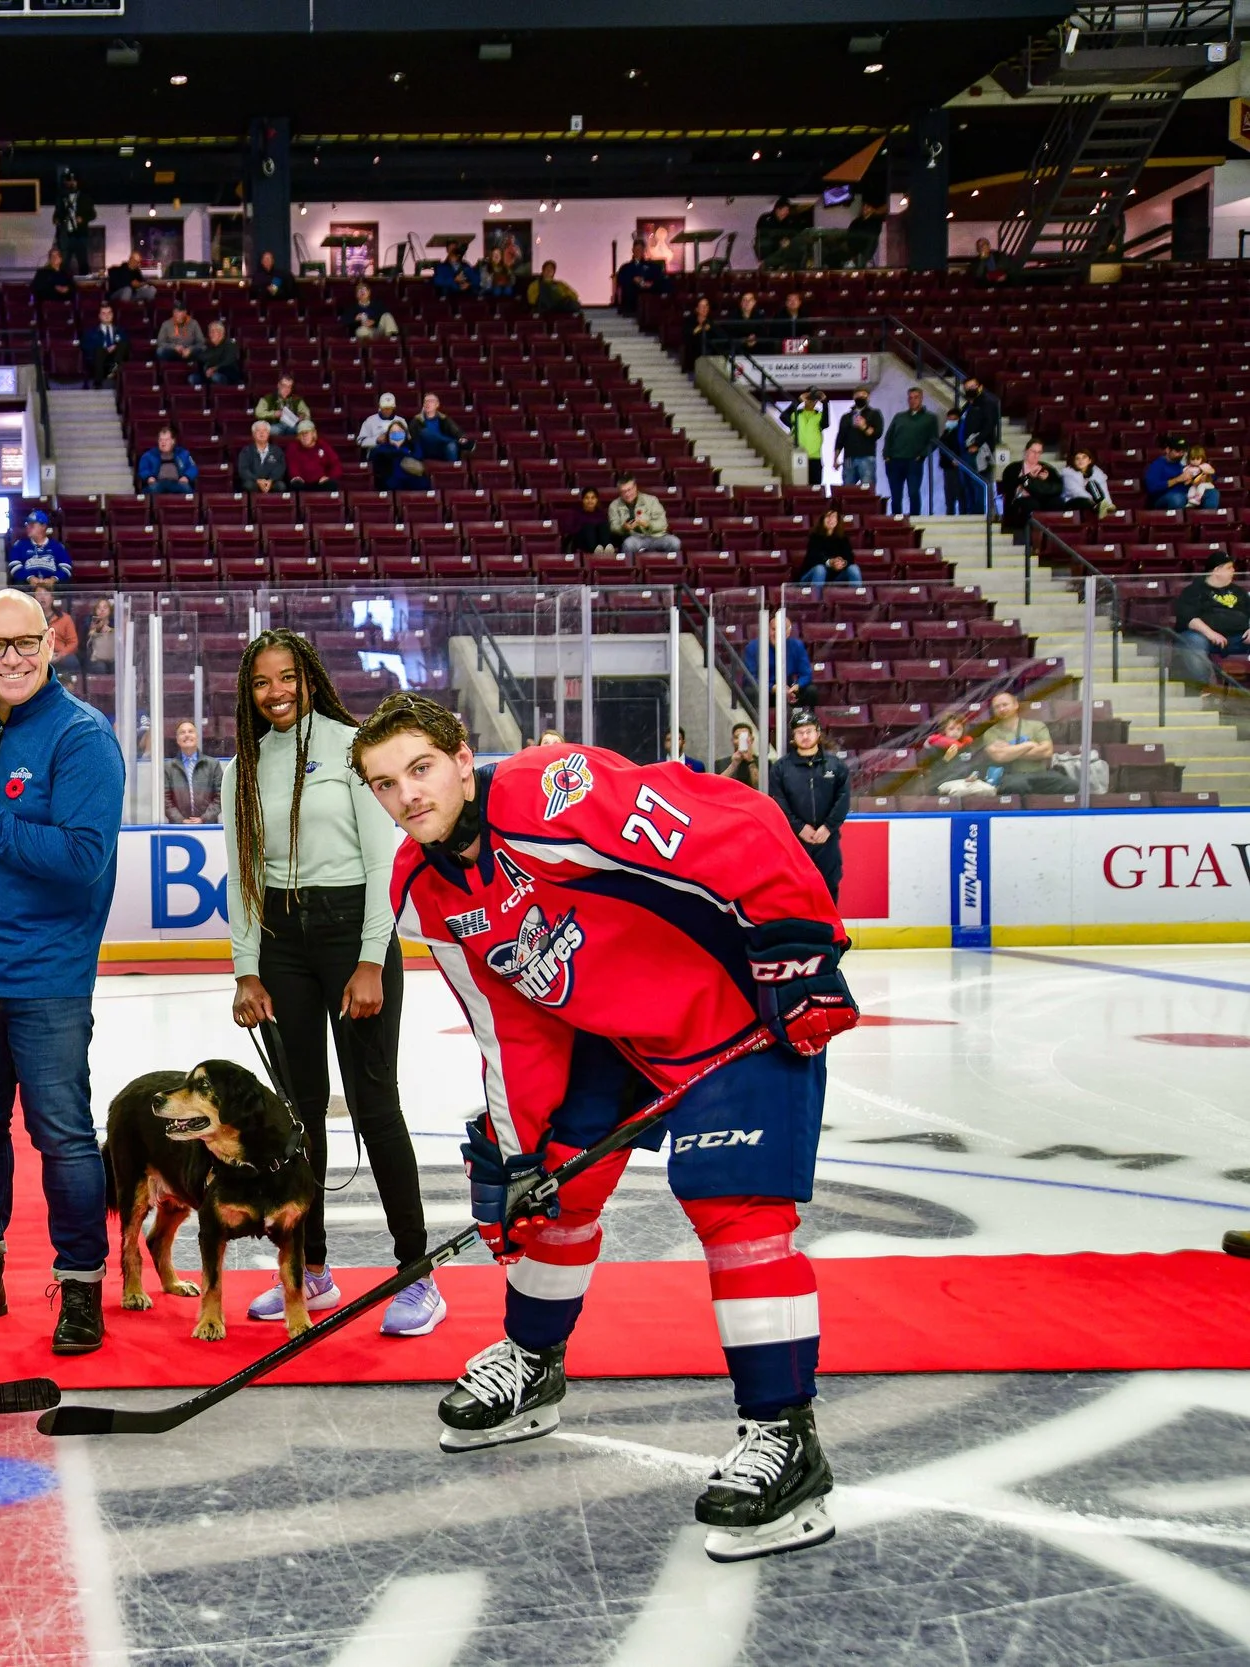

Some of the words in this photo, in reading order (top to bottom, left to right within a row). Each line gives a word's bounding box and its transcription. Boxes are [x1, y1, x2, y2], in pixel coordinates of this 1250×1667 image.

[621, 783, 693, 861] 27
[493, 848, 535, 890] A
[963, 823, 978, 908] WINMAR.ca
[501, 883, 534, 914] CCM
[749, 954, 825, 981] CM
[674, 1129, 764, 1155] CCM
